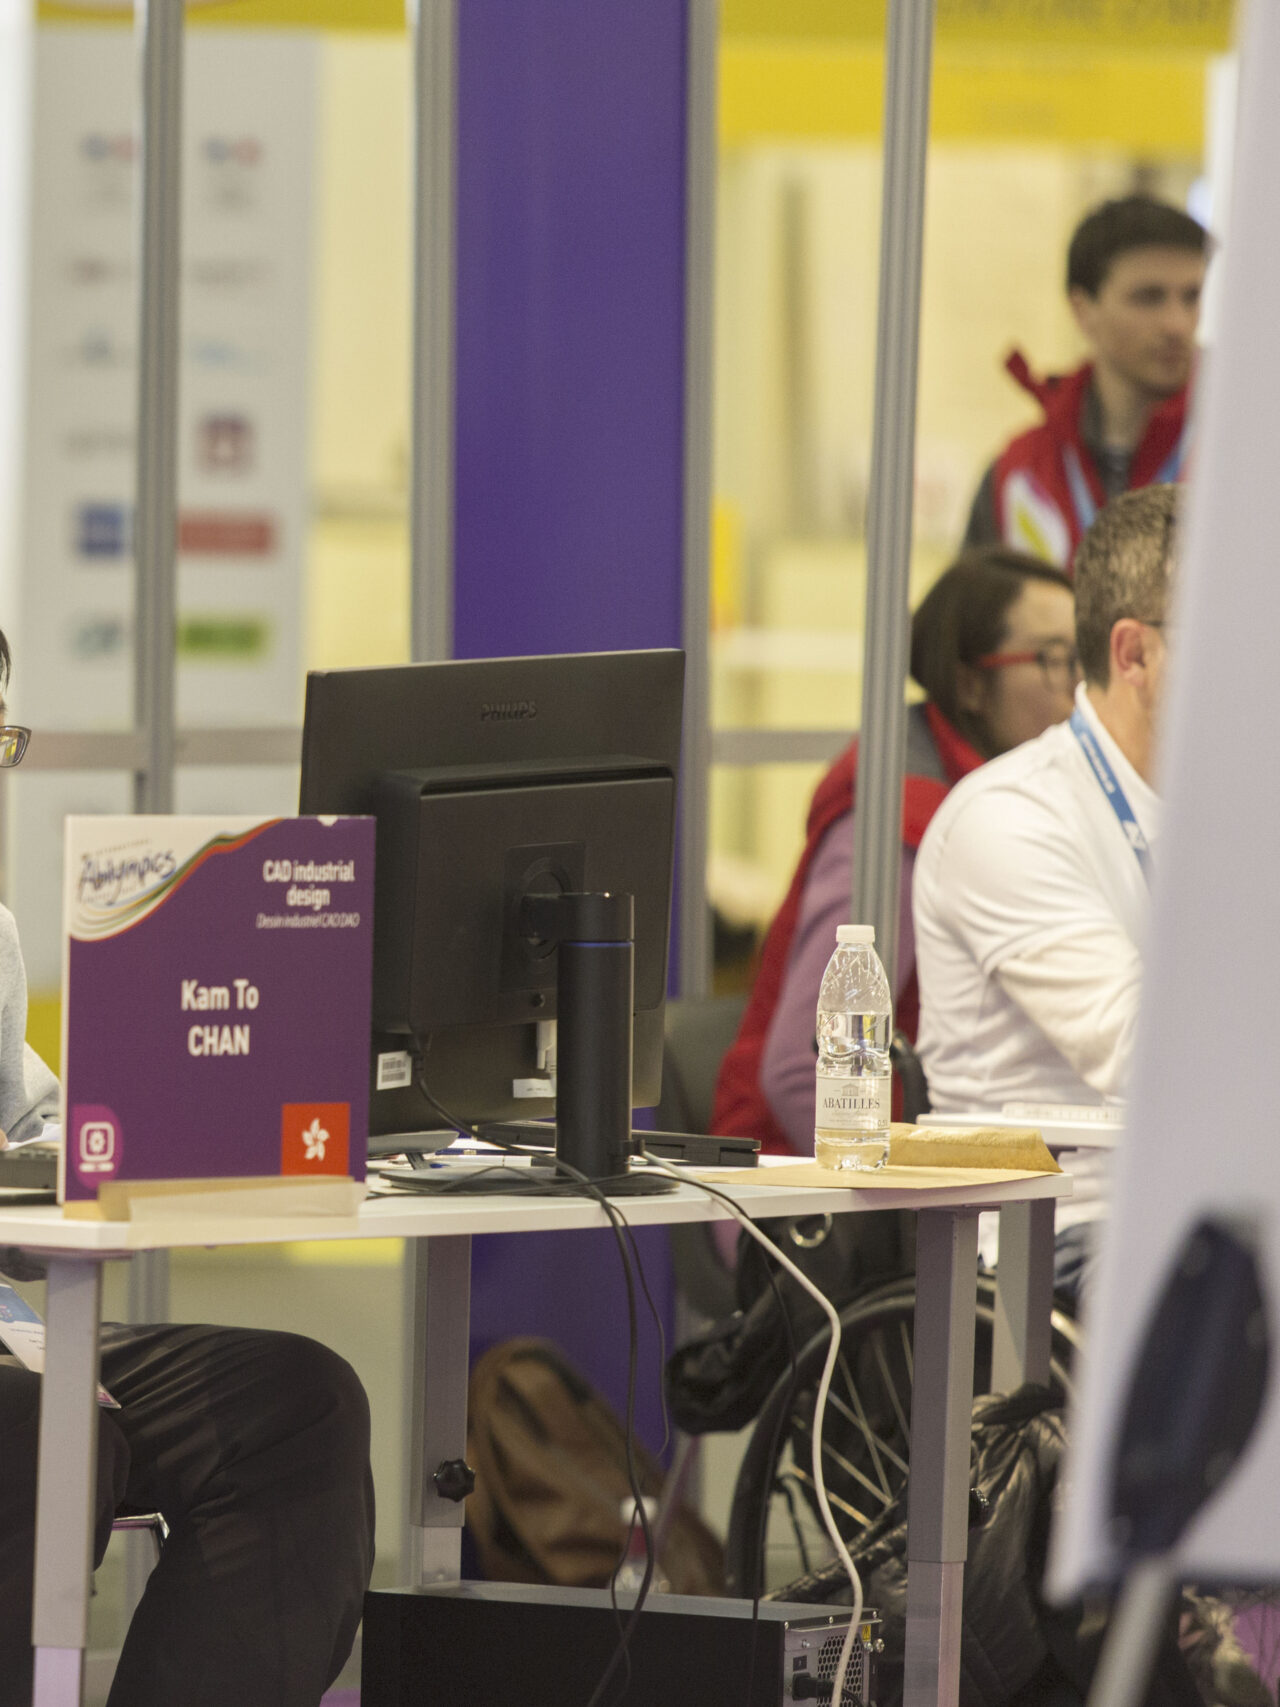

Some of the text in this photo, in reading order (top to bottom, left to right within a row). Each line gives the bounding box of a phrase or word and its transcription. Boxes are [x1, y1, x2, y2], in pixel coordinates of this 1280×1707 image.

[263, 859, 355, 882] CAD industrial
[286, 883, 330, 911] design
[181, 979, 259, 1011] Kam To
[188, 1024, 250, 1056] CHAN
[823, 1097, 880, 1109] ABATILLES
